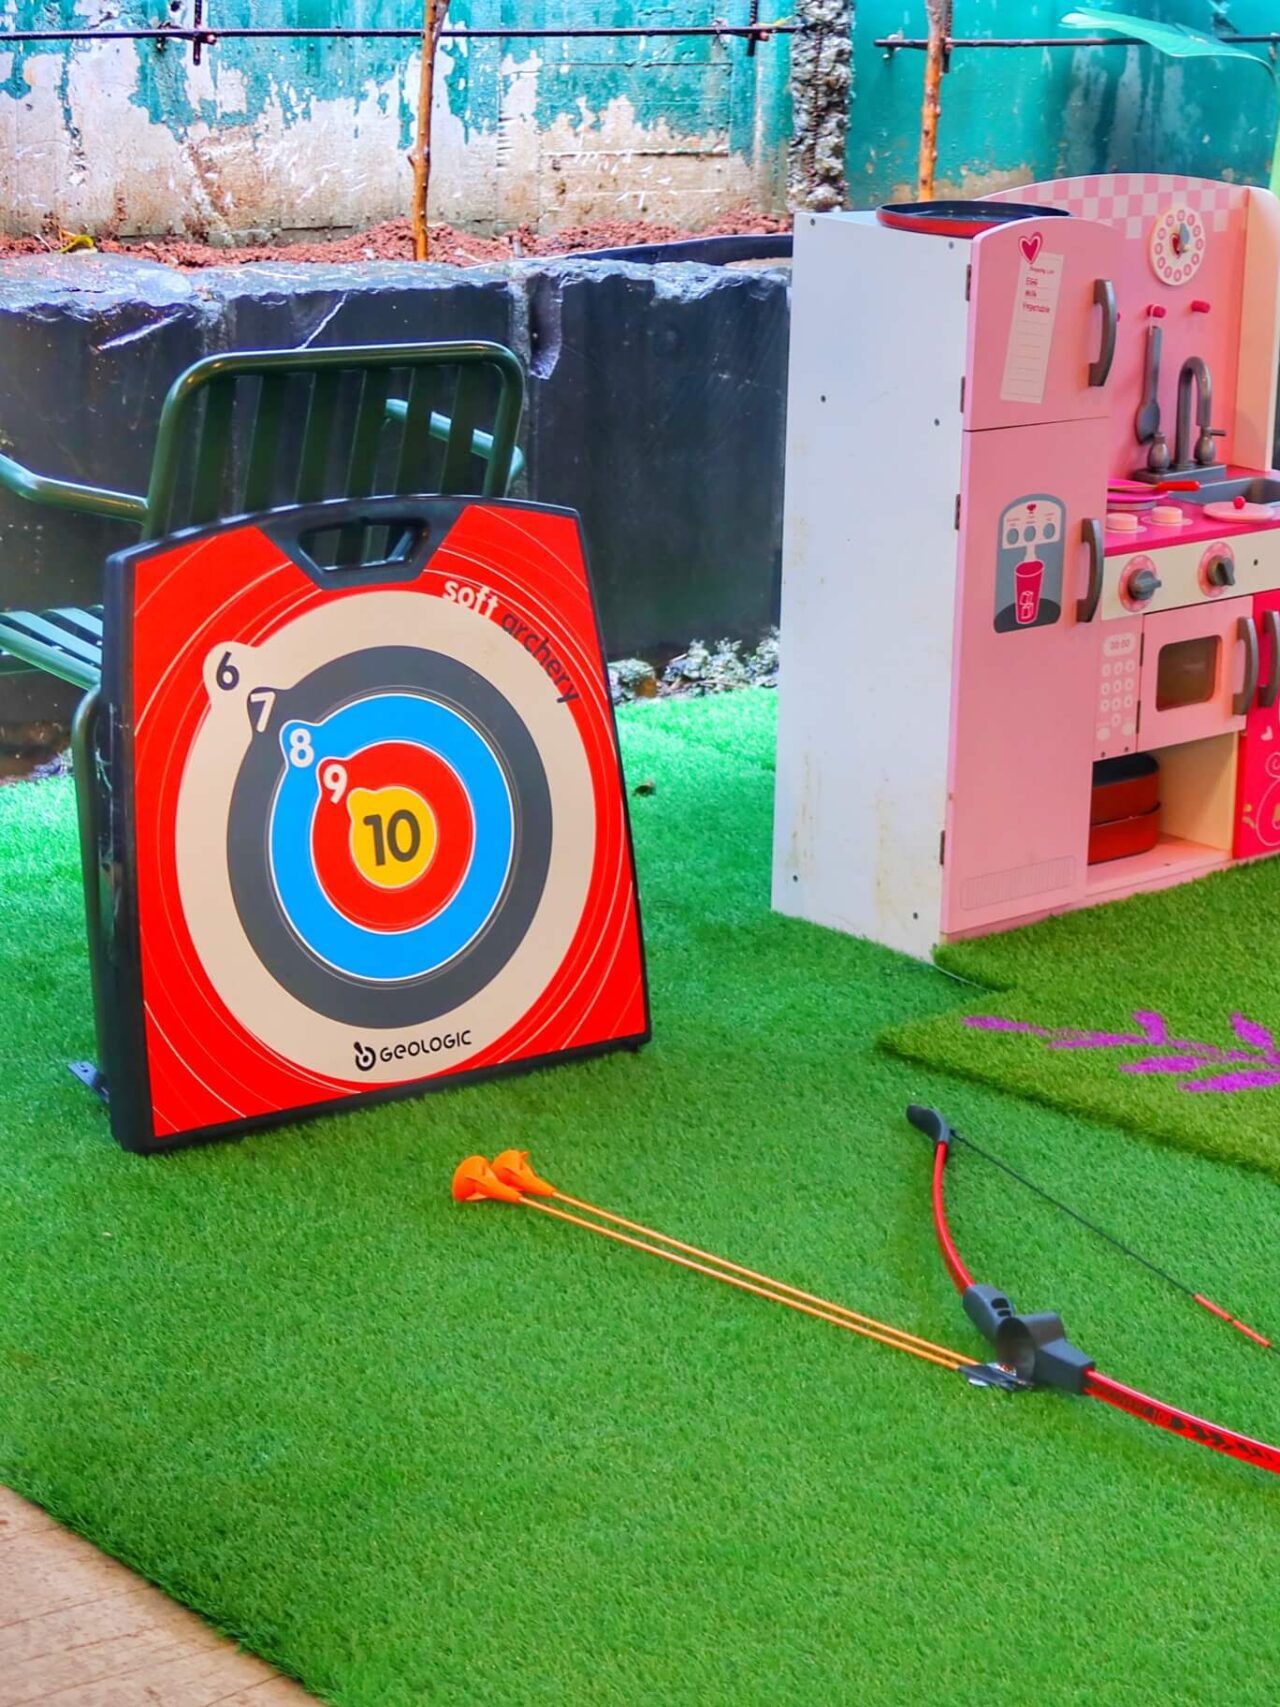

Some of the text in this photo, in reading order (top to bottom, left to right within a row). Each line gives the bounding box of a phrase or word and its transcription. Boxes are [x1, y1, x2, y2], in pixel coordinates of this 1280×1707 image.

[442, 580, 580, 703] soft archery
[215, 650, 240, 691] 6
[250, 691, 276, 733] 7
[289, 727, 315, 769] 8
[323, 763, 348, 804] 9
[363, 809, 421, 867] 10
[380, 1030, 472, 1063] GEOLOGIC
